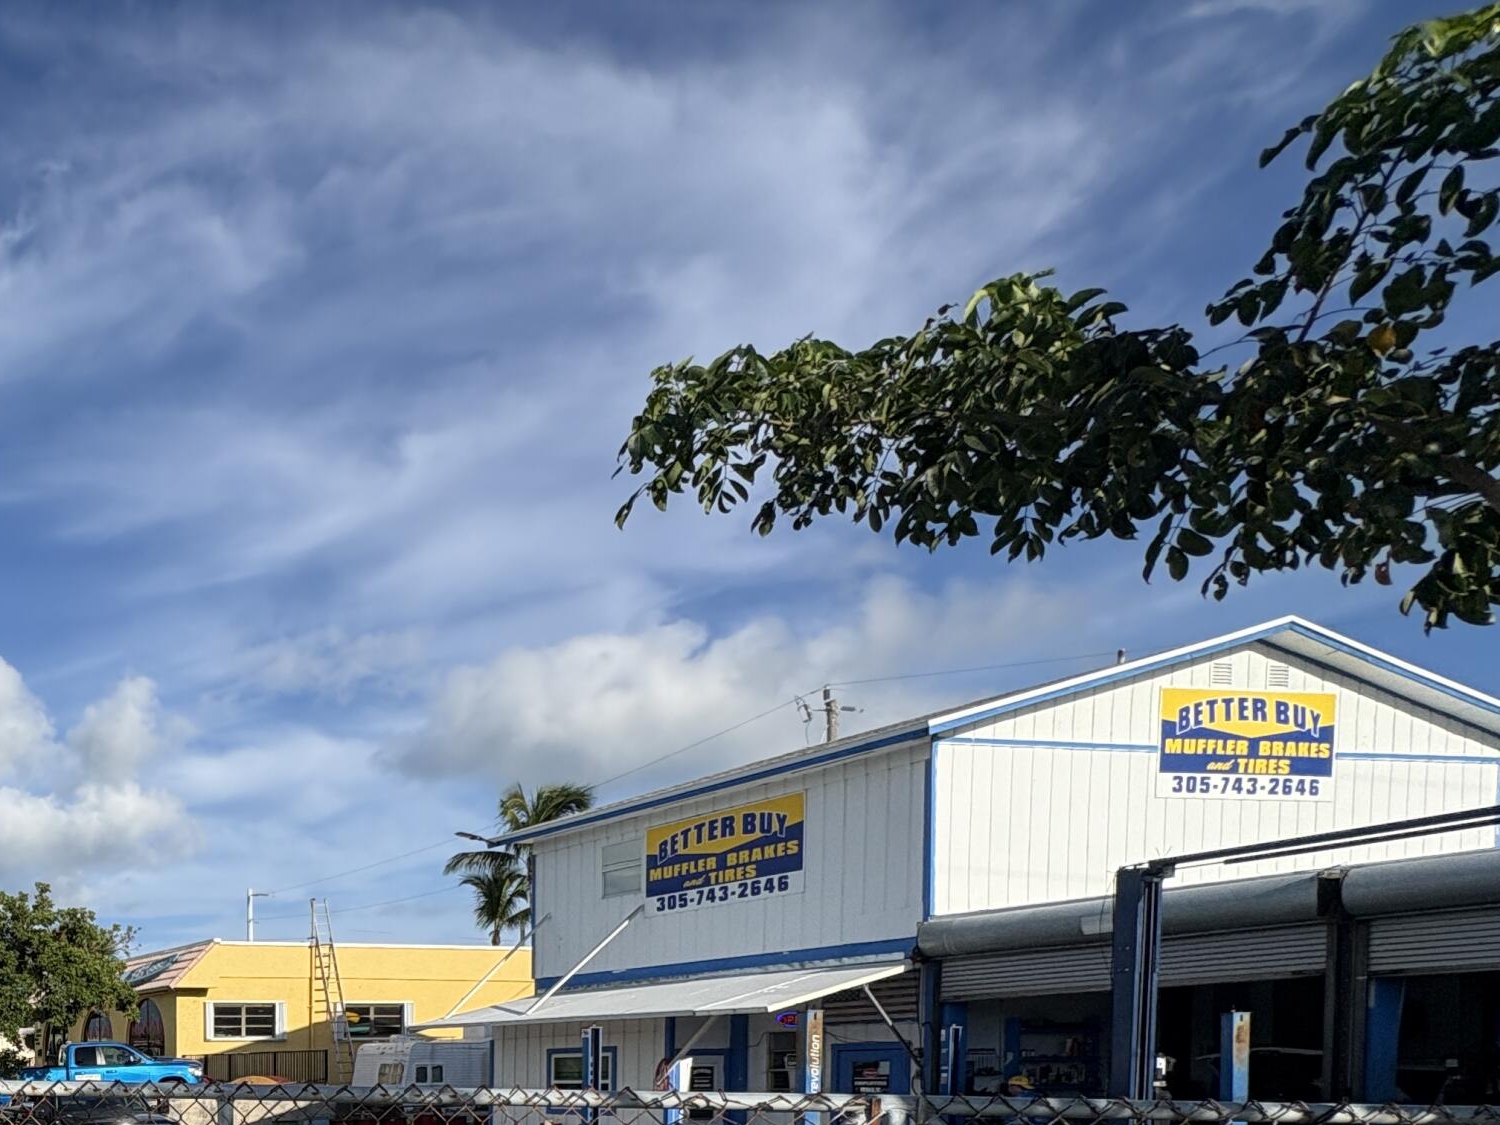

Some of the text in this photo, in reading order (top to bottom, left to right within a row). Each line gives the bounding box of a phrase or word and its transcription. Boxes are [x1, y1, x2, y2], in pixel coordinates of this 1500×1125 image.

[1176, 697, 1321, 738] BETTER BUY
[1165, 738, 1331, 759] MUFFLER BRAKES
[1206, 758, 1291, 775] and TIRES
[1172, 775, 1320, 796] 305-743-2646
[657, 811, 788, 864] BETTER BUY
[649, 840, 800, 882] MUFFLER BRAKES
[682, 864, 757, 888] and TIRES
[656, 875, 789, 912] 305-743-2646
[809, 1034, 821, 1094] revolution
